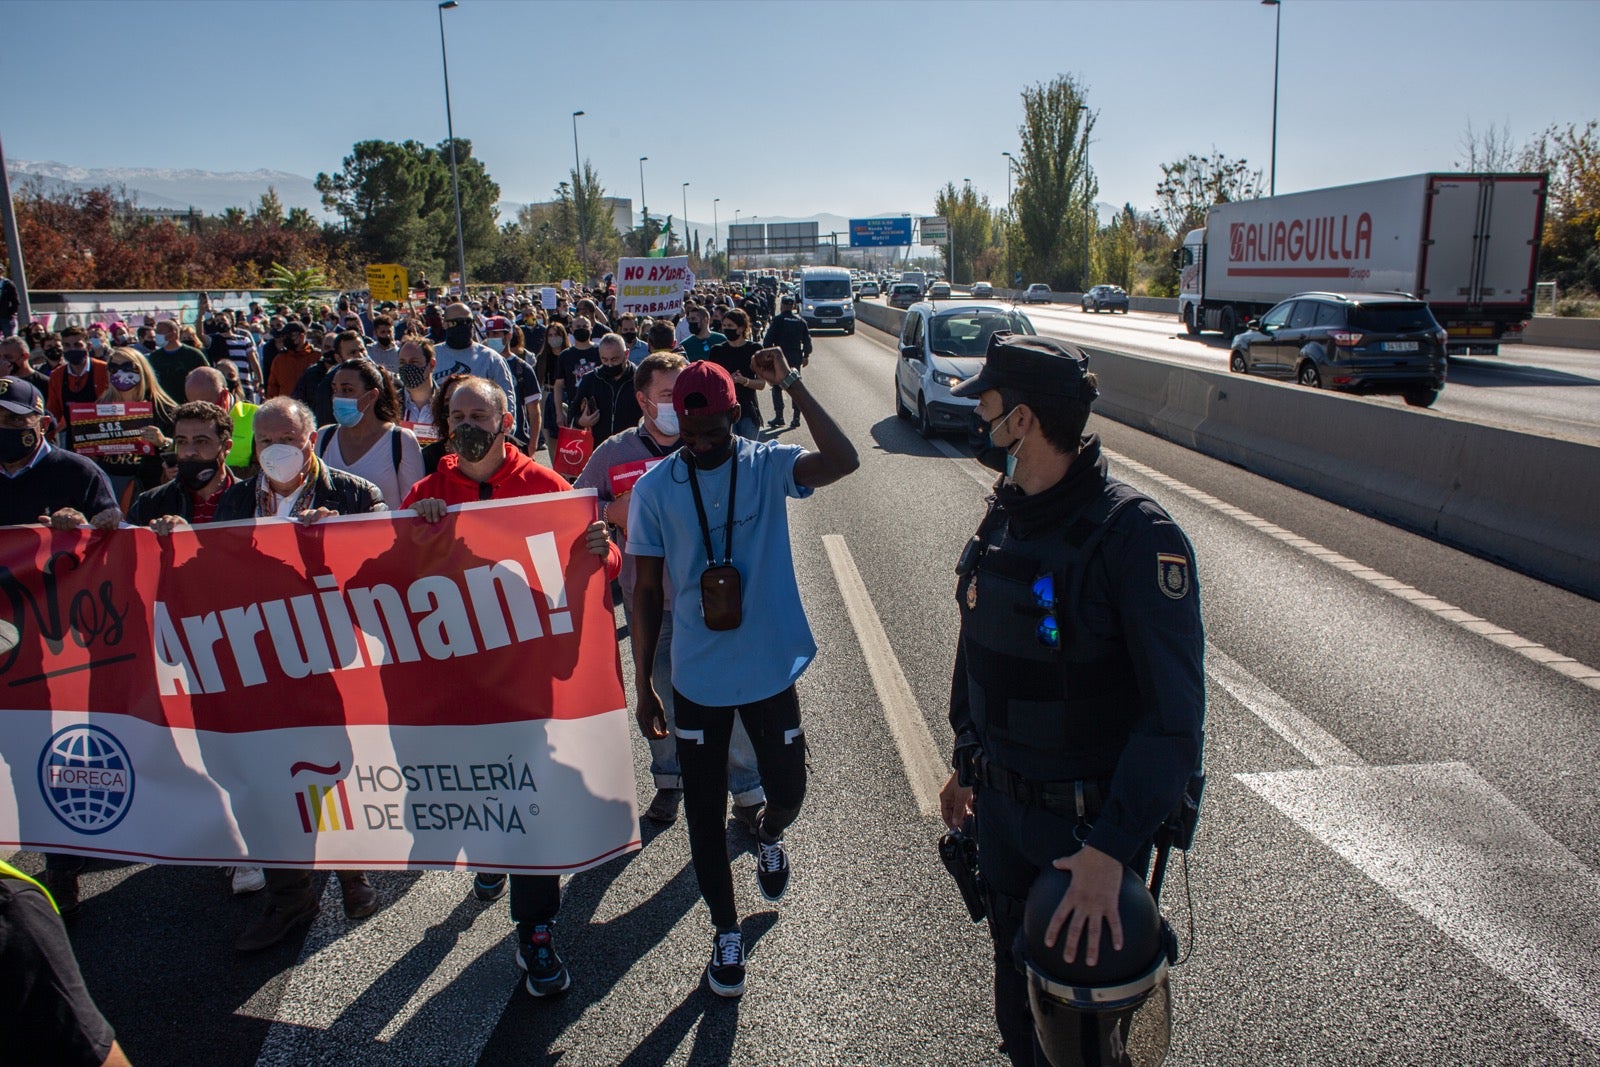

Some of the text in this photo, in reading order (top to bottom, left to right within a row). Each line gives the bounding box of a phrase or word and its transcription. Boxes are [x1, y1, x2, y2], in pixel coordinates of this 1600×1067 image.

[1245, 212, 1372, 262] ALIAGUILLA
[624, 266, 644, 280] NO
[154, 531, 574, 697] Arruinan!
[50, 769, 124, 787] HORECA
[355, 754, 538, 792] HOSTELERÍA
[364, 804, 403, 830] DE
[412, 796, 526, 834] ESPAÑA
